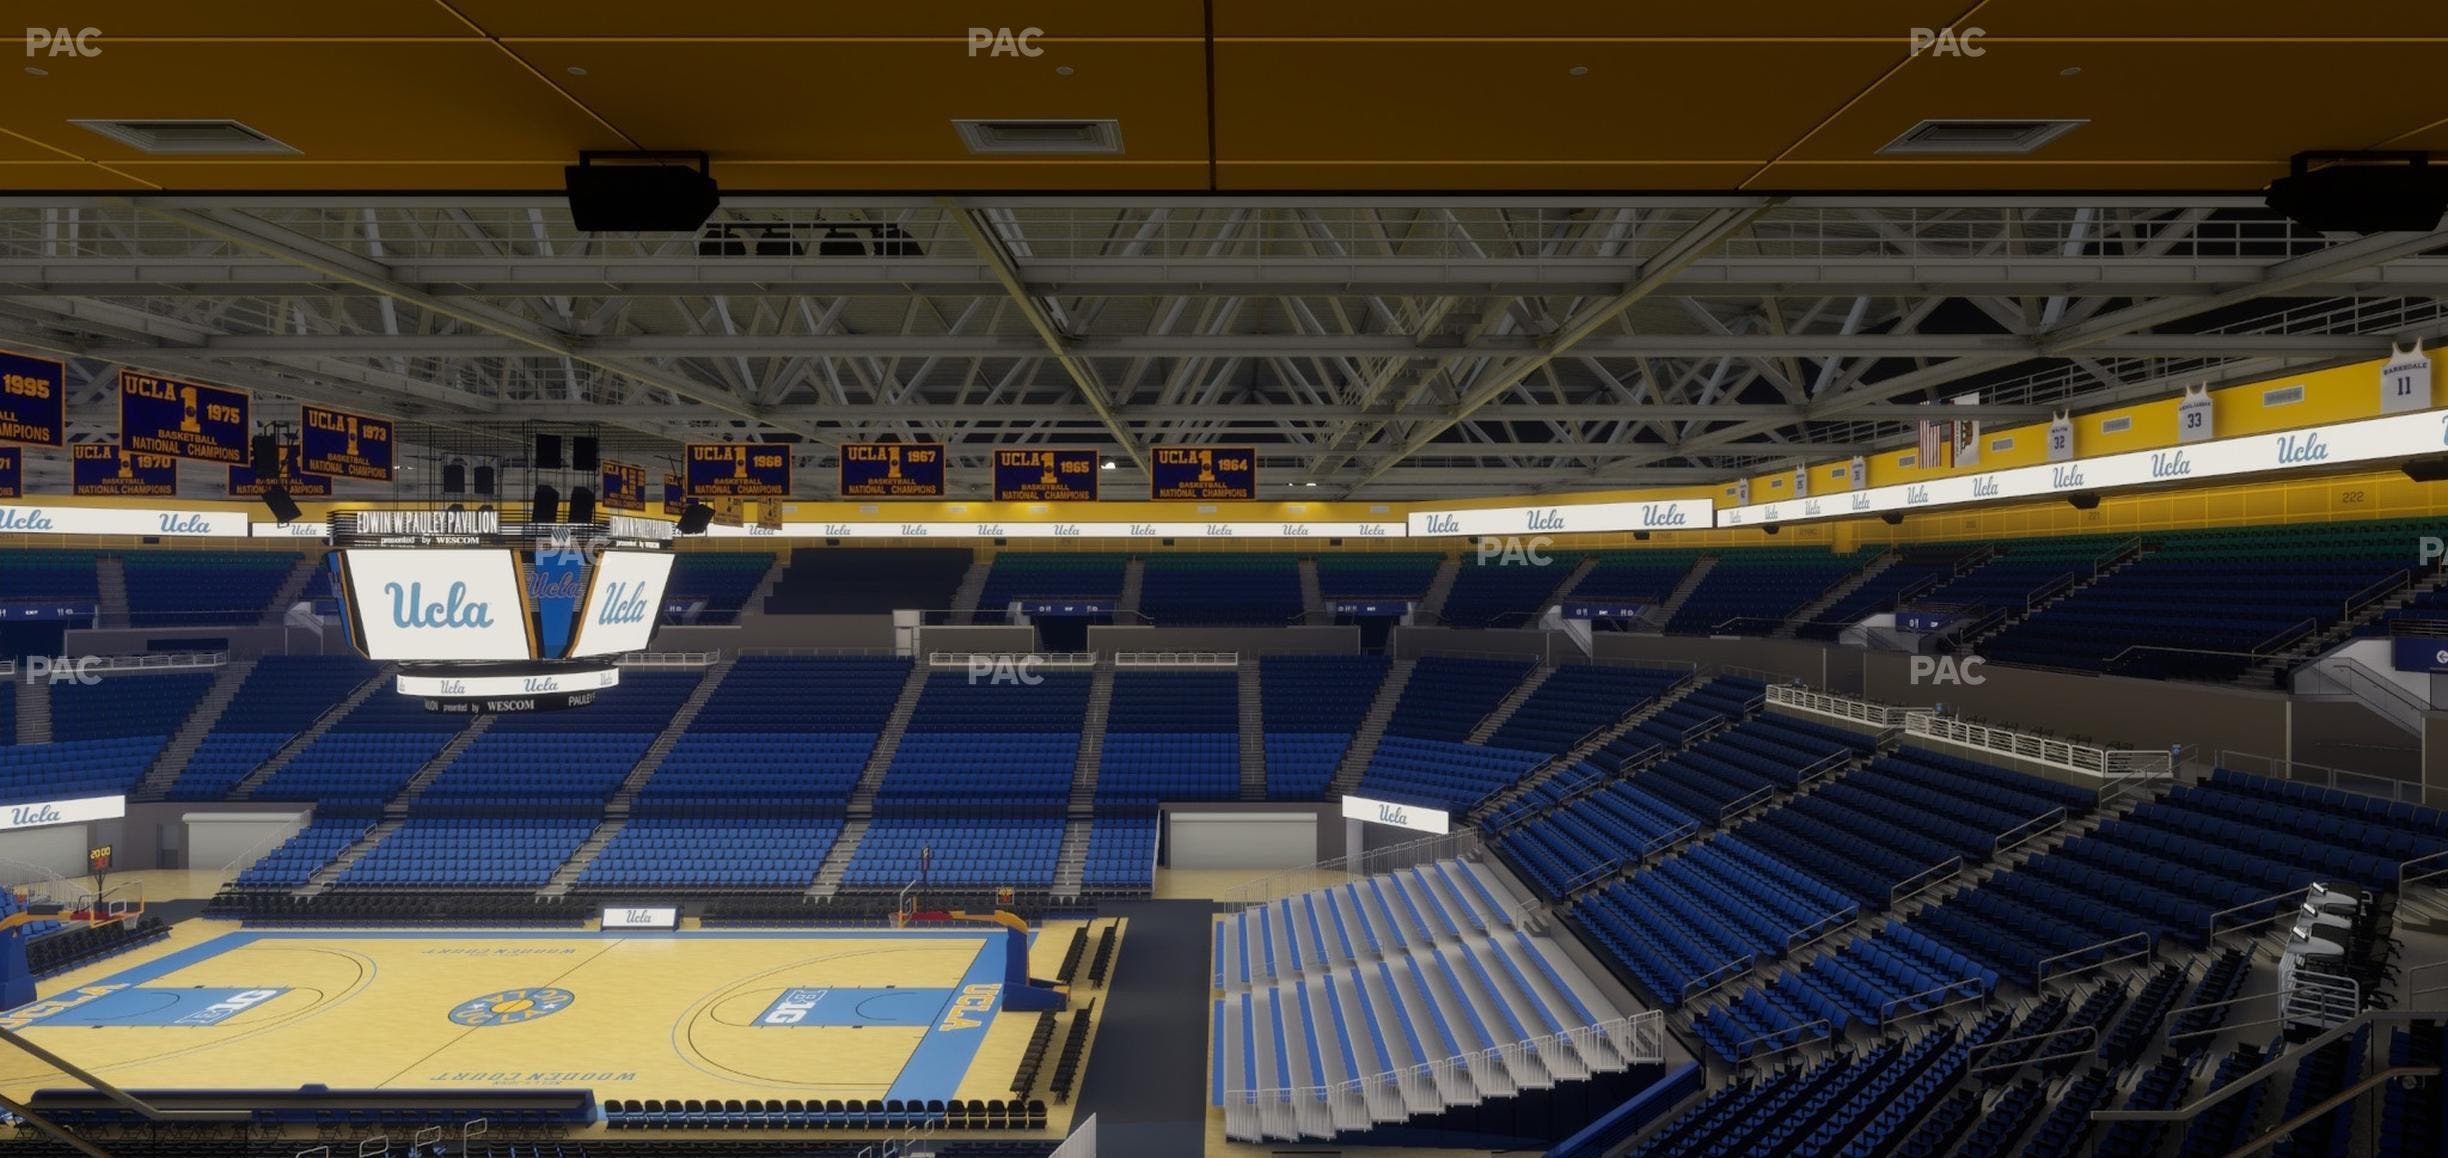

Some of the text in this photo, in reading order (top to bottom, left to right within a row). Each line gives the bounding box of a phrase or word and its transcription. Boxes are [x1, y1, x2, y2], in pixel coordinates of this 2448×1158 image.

[3, 374, 50, 399] 1995
[2397, 376, 2411, 396] 11
[125, 375, 176, 401] UCLA
[206, 403, 241, 424] 1975
[308, 410, 345, 432] UCLA
[362, 425, 387, 441] 1973
[2187, 411, 2202, 429] 33
[0, 424, 50, 442] AMPIONS
[158, 429, 218, 446] BASKETBALL
[132, 434, 241, 462] NATIONAL CHAMPIONS
[2054, 435, 2065, 450] 32
[2277, 432, 2328, 464] Ucla
[75, 446, 112, 460] UCLA
[137, 455, 171, 469] 1970
[327, 453, 371, 466] BASKETBALL
[693, 446, 733, 461] UCLA
[752, 455, 783, 469] 1968
[847, 446, 887, 461] UCLA
[907, 451, 936, 464] 1967
[1001, 452, 1040, 466] UCLA
[1060, 460, 1090, 473] 1965
[1158, 450, 1198, 464] UCLA
[1218, 458, 1249, 472] 1964
[2152, 450, 2191, 478] Ucla
[309, 460, 387, 479] NATIONAL CHAMPIONS
[2053, 464, 2084, 488] Ucla
[78, 484, 172, 495] NATIONAL CHAMPIONS
[694, 484, 783, 495] NATIONAL CHAMPIONS
[713, 478, 762, 486] BASKETBALL
[848, 484, 937, 495] NATIONAL CHAMPIONS
[867, 478, 917, 486] BASKETBALL
[1021, 483, 1070, 491] BASKETBALL
[1178, 482, 1228, 490] BASKETBALL
[1973, 475, 1998, 497] Ucla
[1001, 490, 1090, 500] NATIONAL CHAMPIONS
[1159, 488, 1248, 498] NATIONAL CHAMPIONS
[1907, 485, 1928, 504] Ucla
[2343, 491, 2365, 503] 222
[159, 513, 211, 533] Ucla
[356, 511, 498, 534] EDWIN W PAULEY PAVILION
[1427, 514, 1459, 533] Ucla
[1527, 509, 1565, 530] Ucla
[1642, 504, 1686, 526] Ucla
[291, 523, 317, 535] Ucla
[825, 525, 850, 535] Ucla
[902, 525, 926, 535] Ucla
[978, 525, 1003, 535] Ucla
[1055, 525, 1079, 535] Ucla
[1131, 525, 1155, 535] Ucla
[1207, 525, 1232, 535] Ucla
[1283, 525, 1308, 535] Ucla
[1359, 525, 1385, 535] Ucla
[380, 536, 480, 546] presented by WESCOM
[384, 581, 494, 628] Ucla
[599, 581, 647, 625] Ucla
[441, 680, 465, 694] Ucla
[524, 677, 559, 692] Ucla
[487, 700, 535, 712] WESCOM
[12, 805, 61, 825] Ucla
[1379, 804, 1408, 825] Ucla
[626, 910, 650, 924] Ucla
[939, 983, 1003, 1032] UCLA
